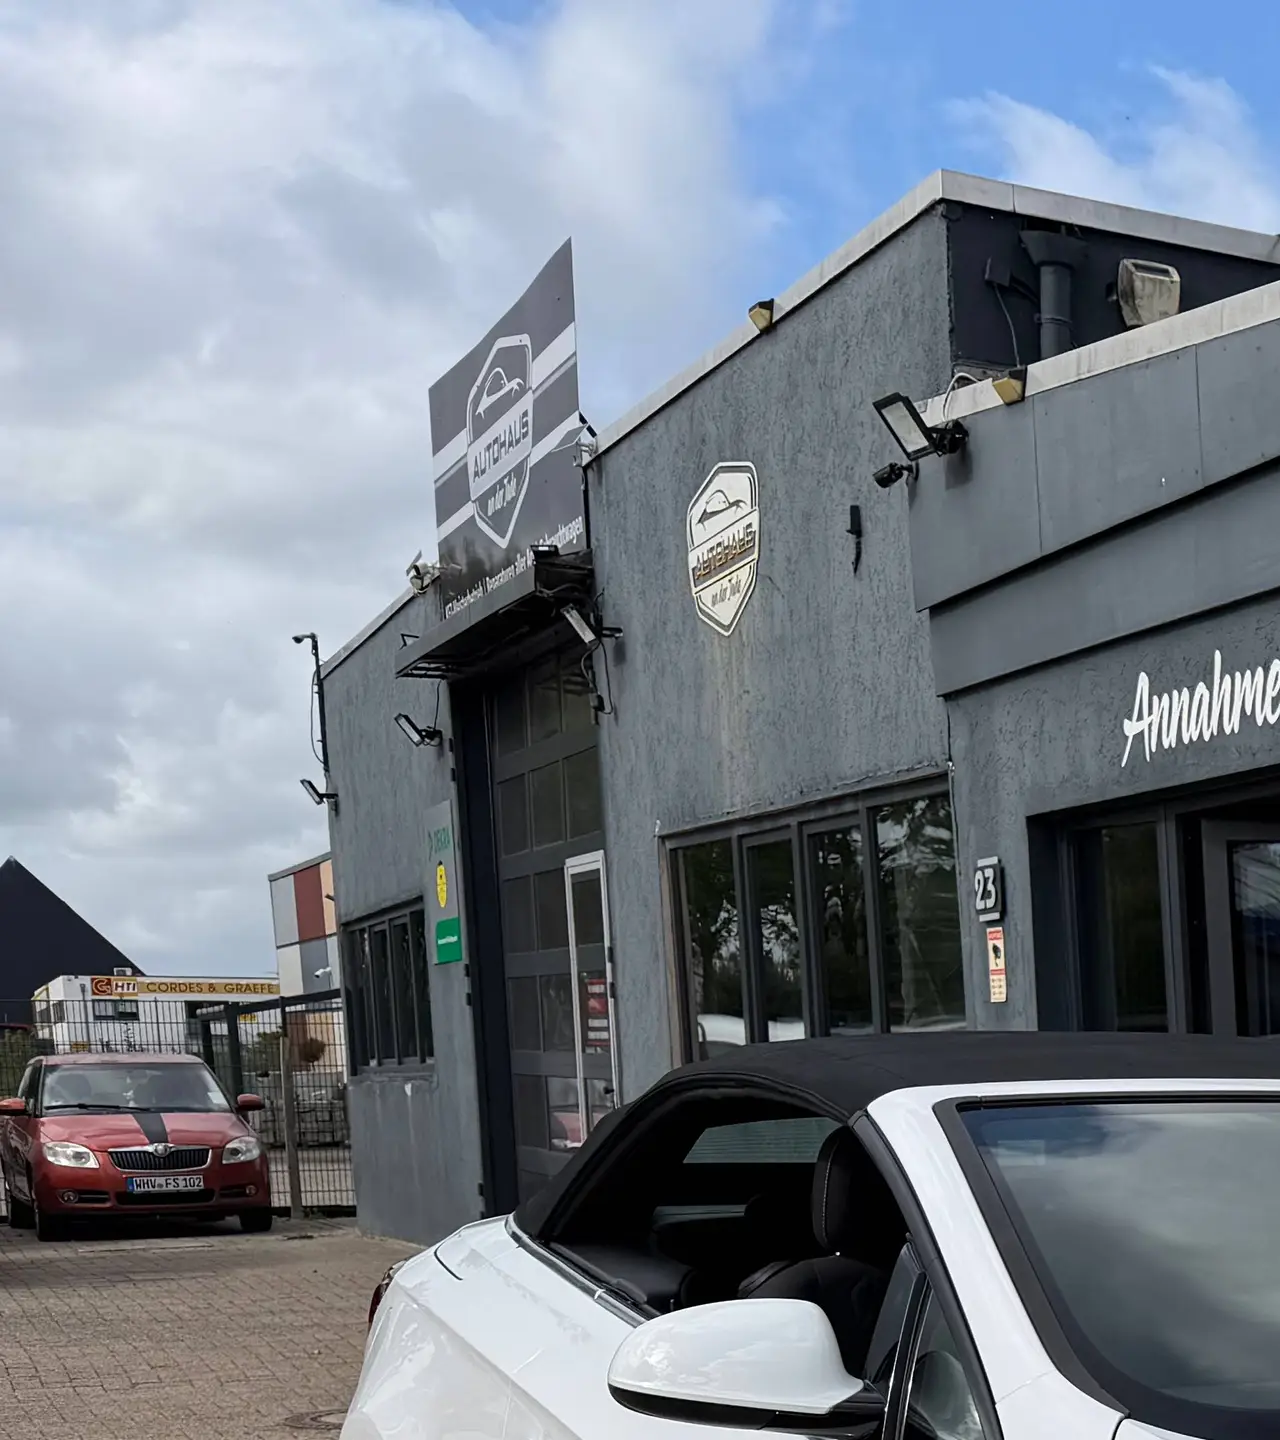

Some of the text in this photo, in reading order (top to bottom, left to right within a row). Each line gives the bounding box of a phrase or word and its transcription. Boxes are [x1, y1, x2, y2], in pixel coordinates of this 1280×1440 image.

[473, 409, 529, 483] AUTOHAUS
[694, 522, 756, 581] AUTOHAUS
[974, 868, 996, 910] 23
[114, 982, 136, 992] HTI
[146, 982, 204, 993] CORDES
[134, 1176, 202, 1189] WHV FS 102
